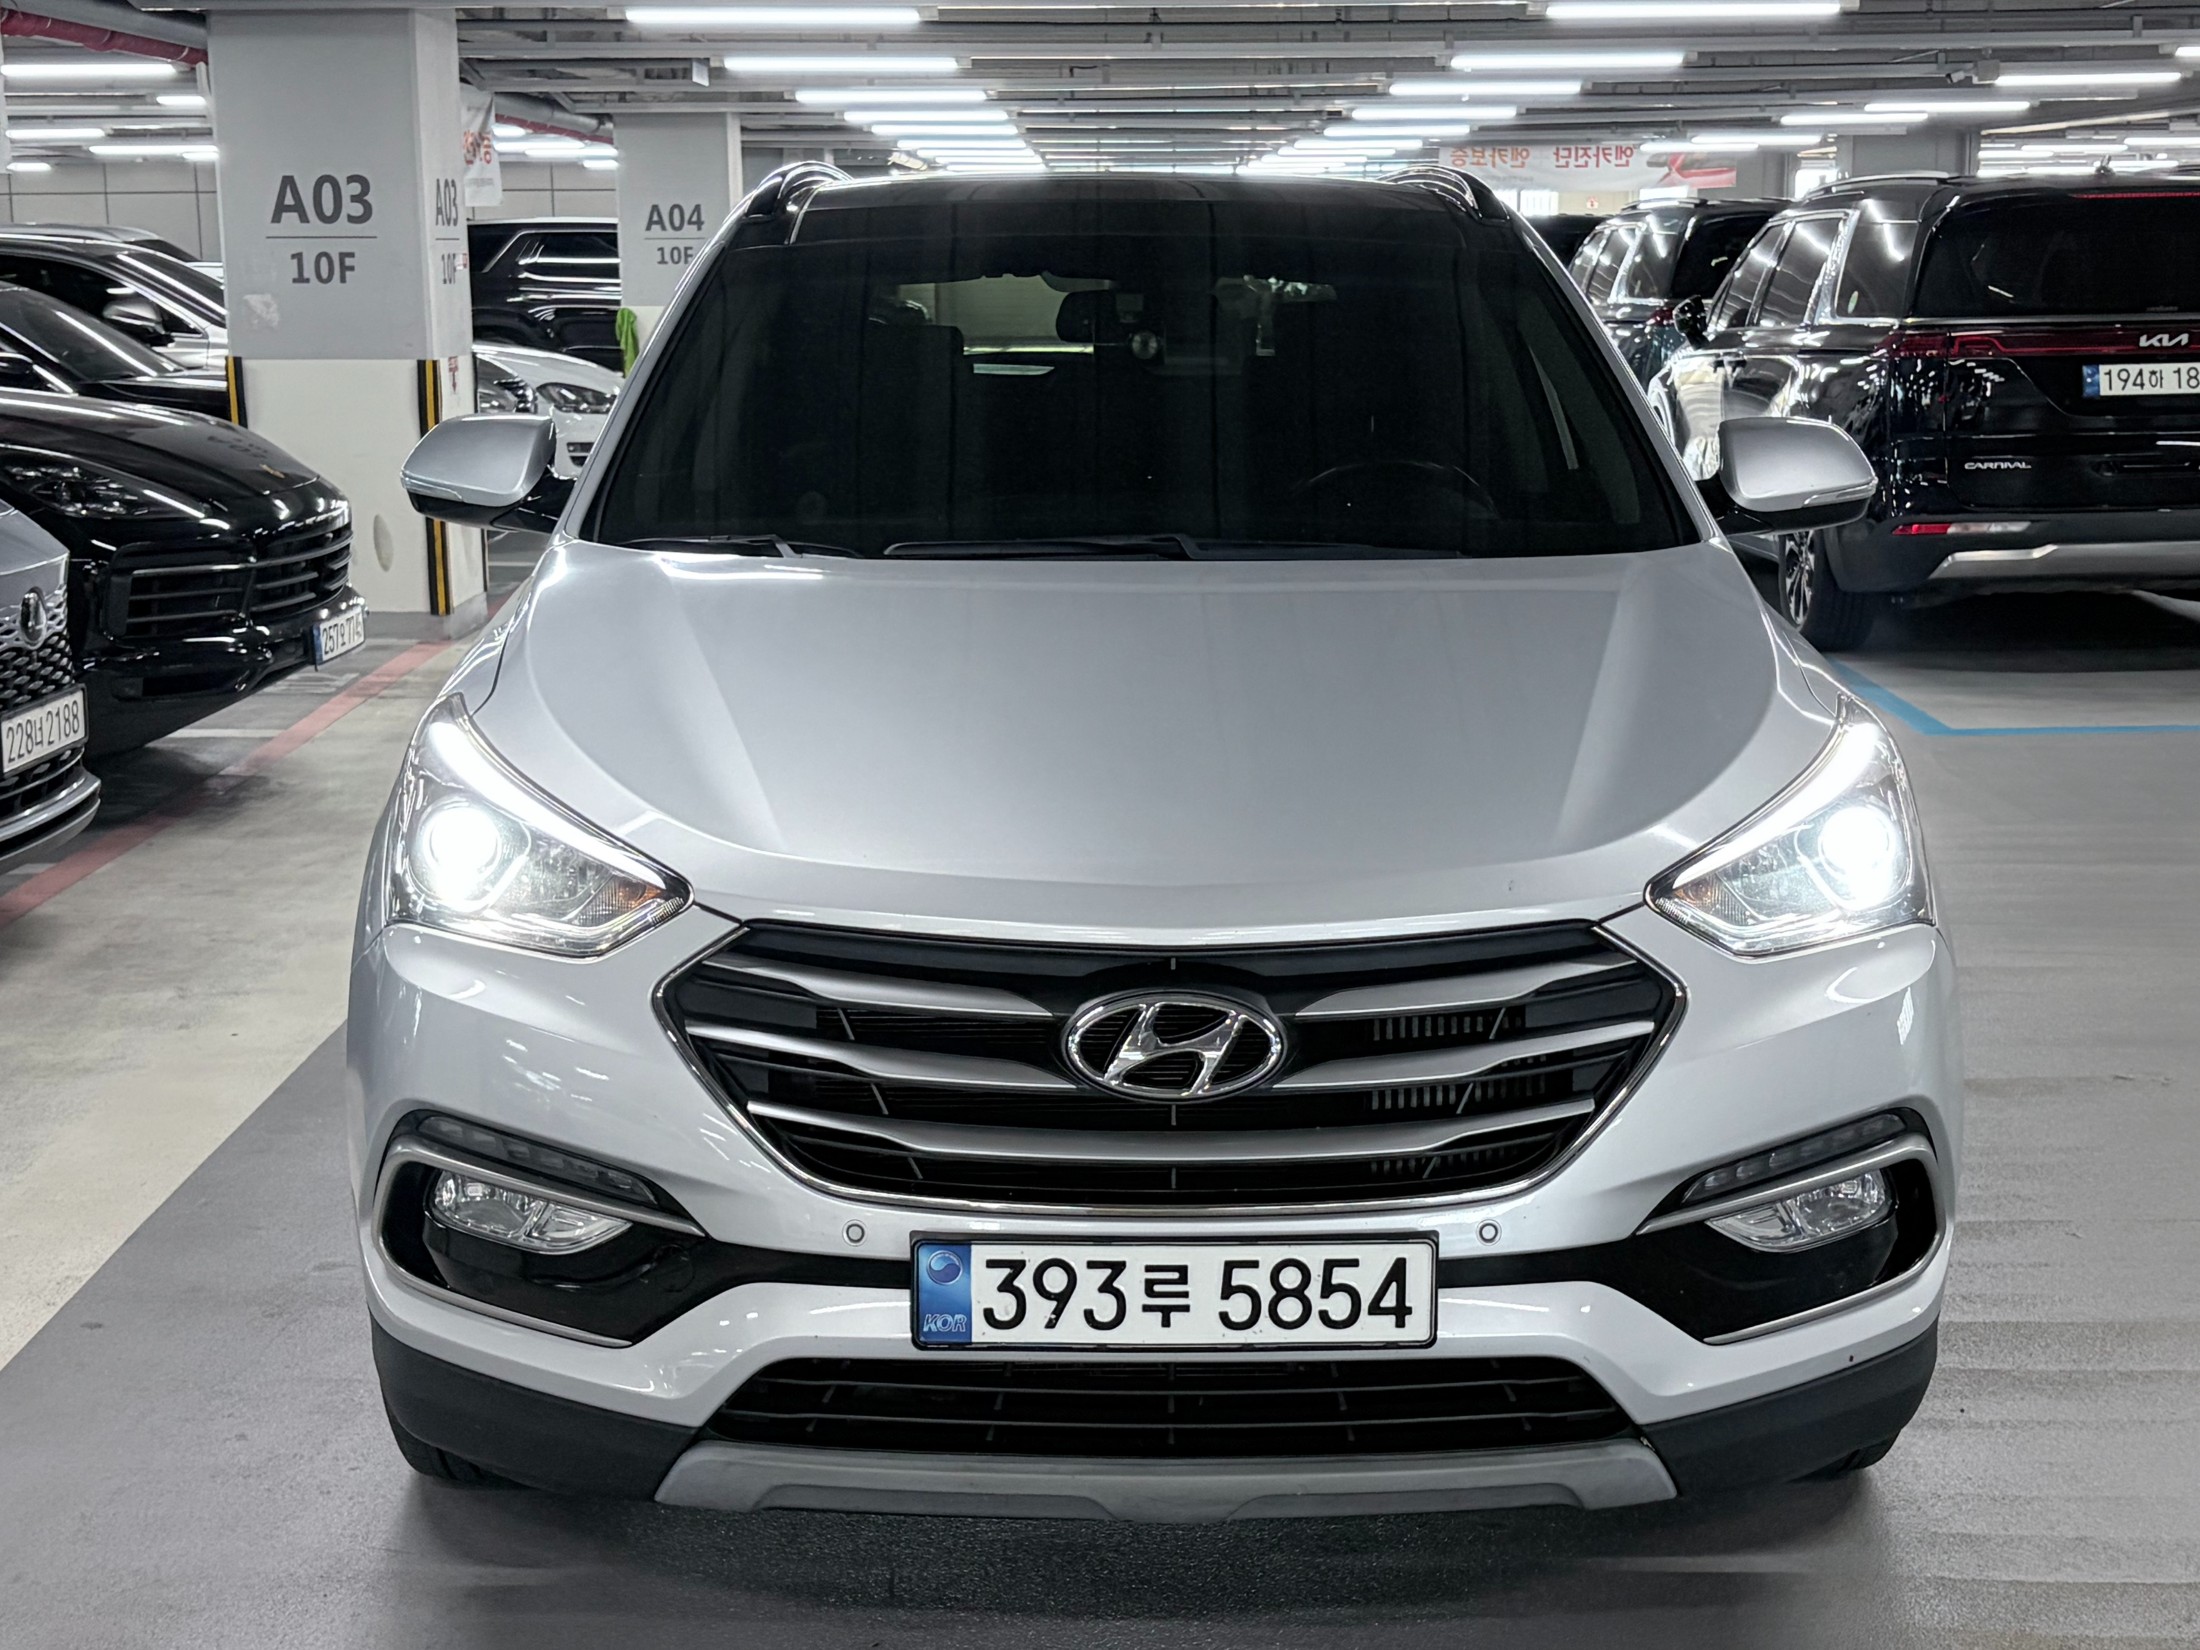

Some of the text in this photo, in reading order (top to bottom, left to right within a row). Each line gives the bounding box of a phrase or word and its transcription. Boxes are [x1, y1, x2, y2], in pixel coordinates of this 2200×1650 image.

[270, 174, 373, 225] A03
[435, 178, 459, 226] A03
[645, 203, 705, 232] A04
[290, 251, 356, 284] 10F
[656, 246, 694, 265] 10F
[2103, 367, 2164, 391] 194하
[1964, 461, 2032, 470] CARNIVAL
[322, 623, 346, 656] 257오
[6, 700, 80, 764] 228너 2188
[983, 1257, 1413, 1331] 393루 5854
[923, 1313, 967, 1332] KOR
